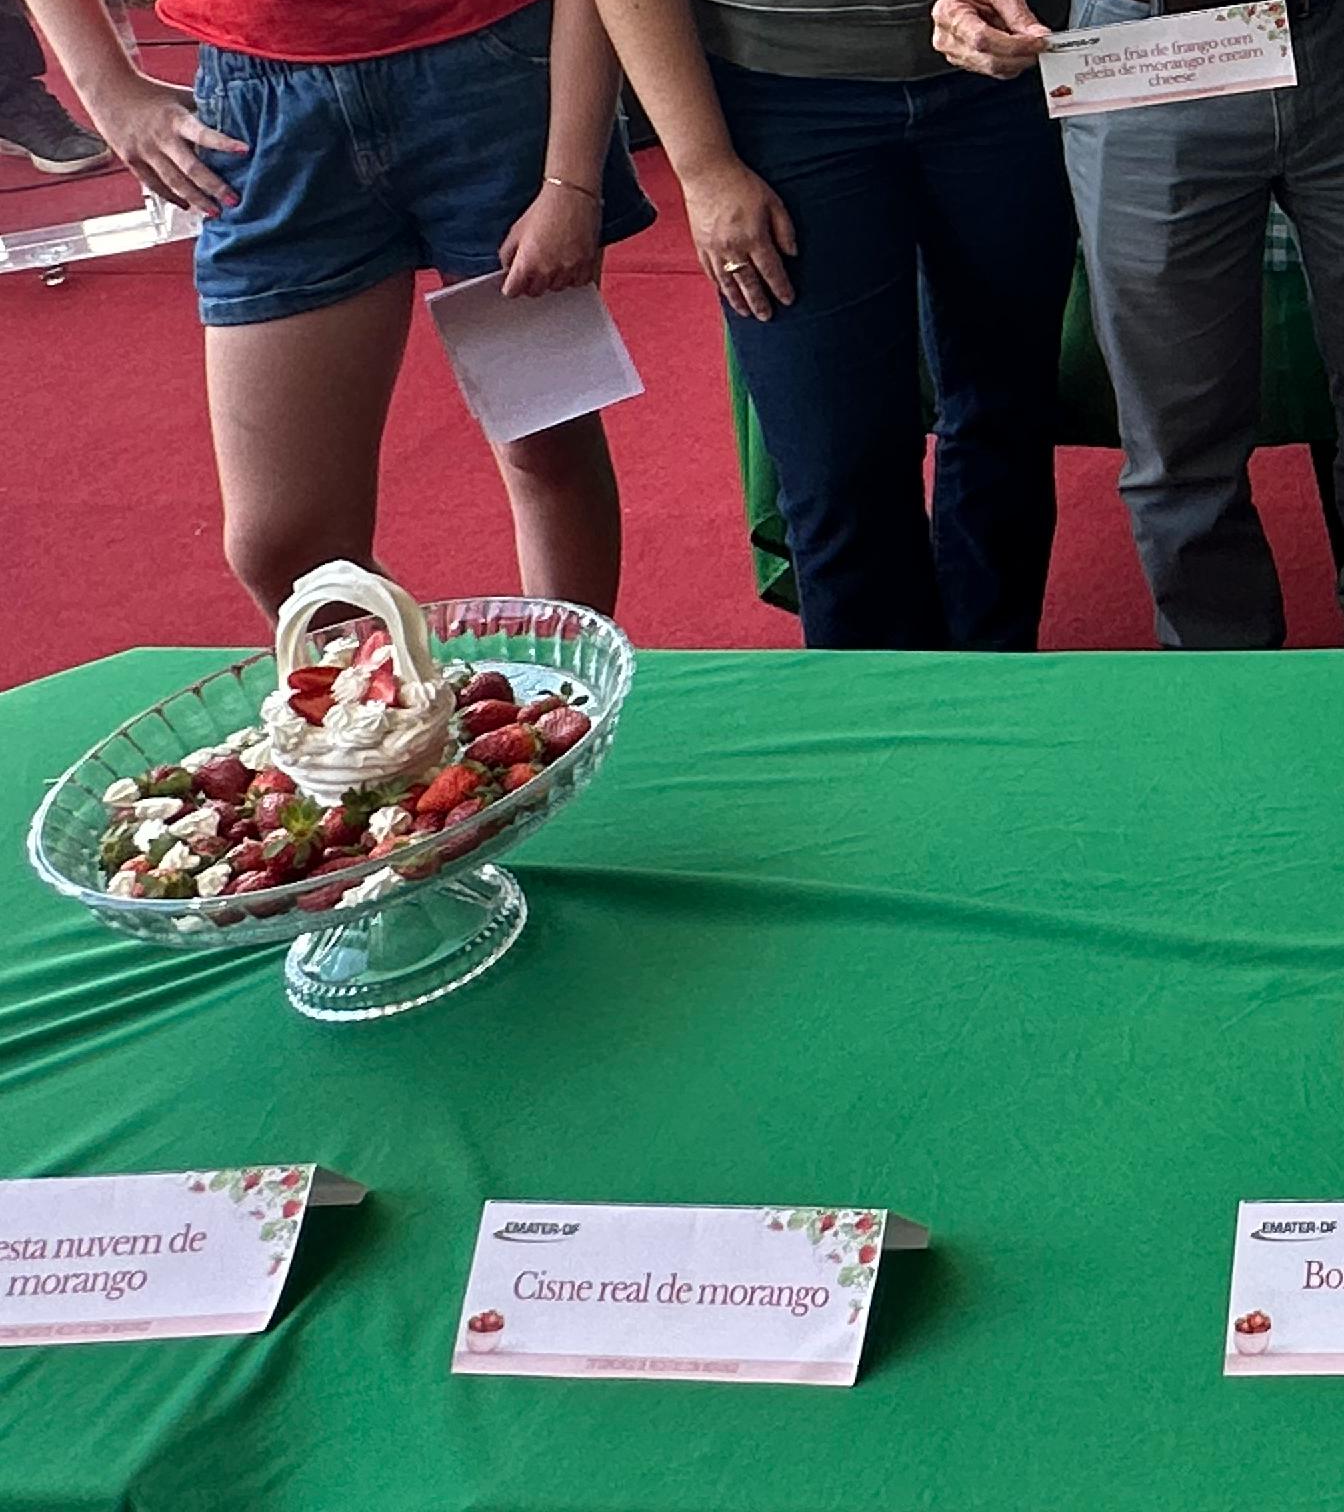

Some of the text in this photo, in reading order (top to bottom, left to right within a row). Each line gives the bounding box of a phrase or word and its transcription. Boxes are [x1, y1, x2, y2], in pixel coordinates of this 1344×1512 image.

[1124, 46, 1149, 62] fria
[1151, 43, 1170, 57] de
[1172, 39, 1219, 55] frango
[1220, 32, 1255, 47] com
[1074, 47, 1264, 85] geleia de morango e cream
[1147, 71, 1197, 88] cheese
[52, 1235, 162, 1259] nuvem
[168, 1222, 208, 1254] de
[5, 1267, 149, 1301] morango
[512, 1269, 831, 1318] Cisne real de morango
